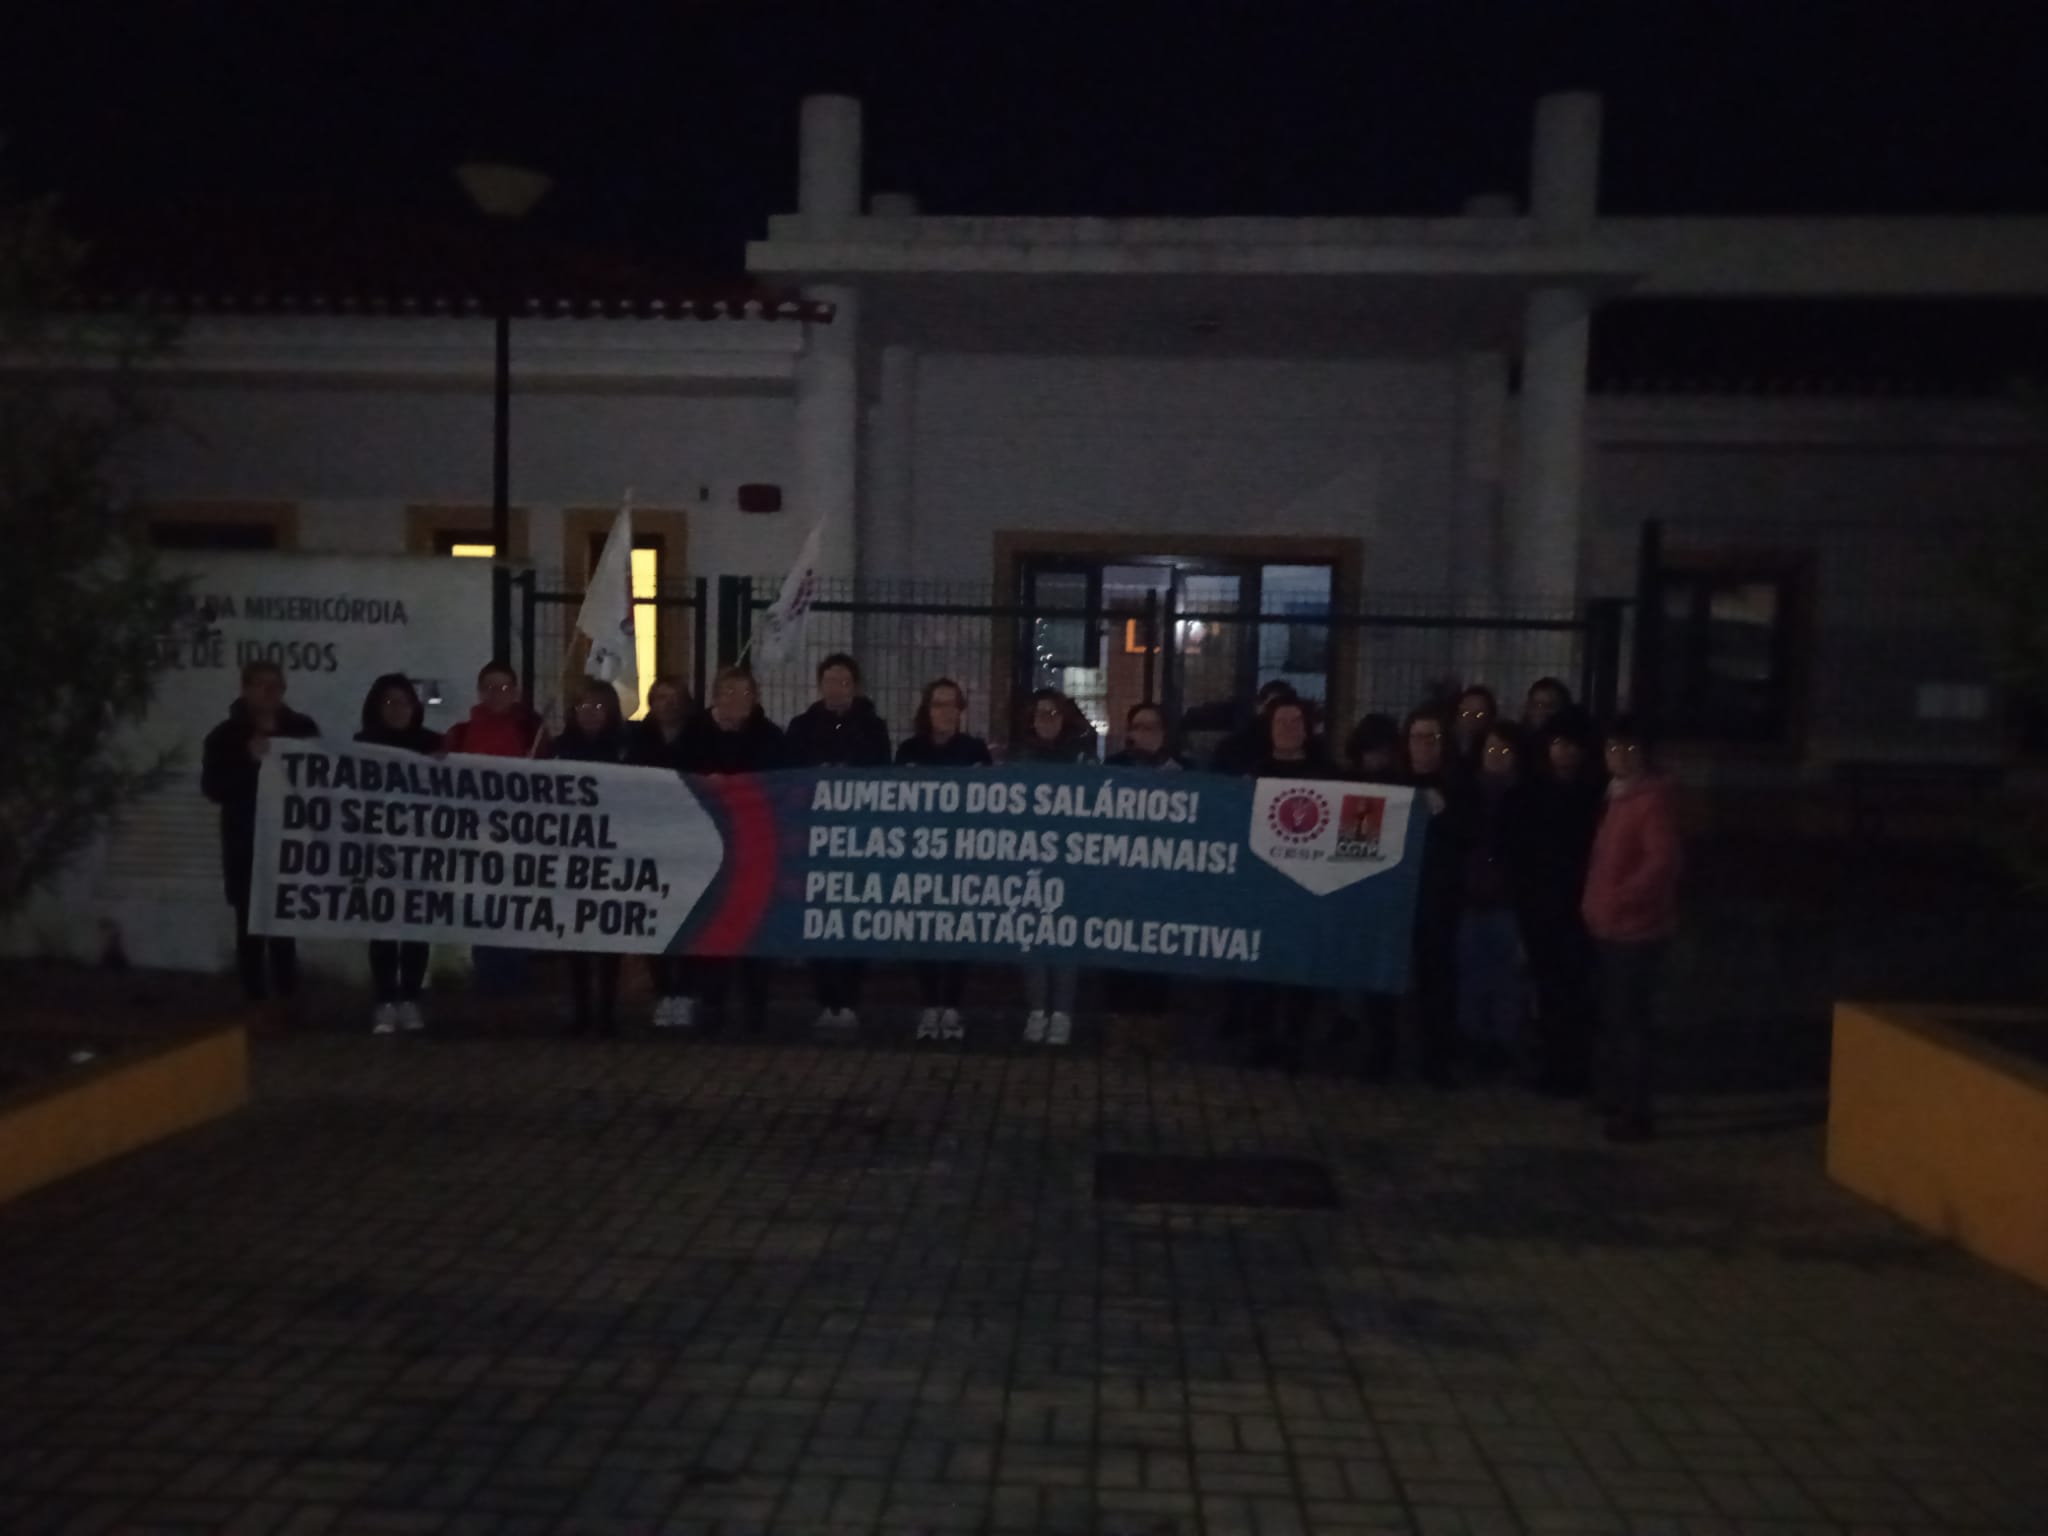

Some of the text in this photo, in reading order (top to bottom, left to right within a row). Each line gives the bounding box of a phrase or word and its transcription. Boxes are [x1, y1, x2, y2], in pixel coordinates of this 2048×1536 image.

[245, 594, 407, 626] MISERICÓRDIA
[192, 639, 224, 669] DE
[238, 641, 338, 673] IDOSOS
[282, 753, 599, 806] TRABALHADORES
[811, 779, 1199, 823] AUMENTO DOS SALÁRIOS!
[283, 795, 617, 849] DO SECTOR SOCIAL
[280, 840, 671, 898] DO DISTRITO DE BEJA,
[808, 825, 1238, 874] PELAS 35 HORAS SEMANAIS!
[275, 874, 657, 939] ESTÃO EM LUTA, POR:
[805, 869, 1064, 914] PELA APLICAÇÃO
[803, 907, 1261, 962] DA CONTRATAÇÃO COLECTIVA!
